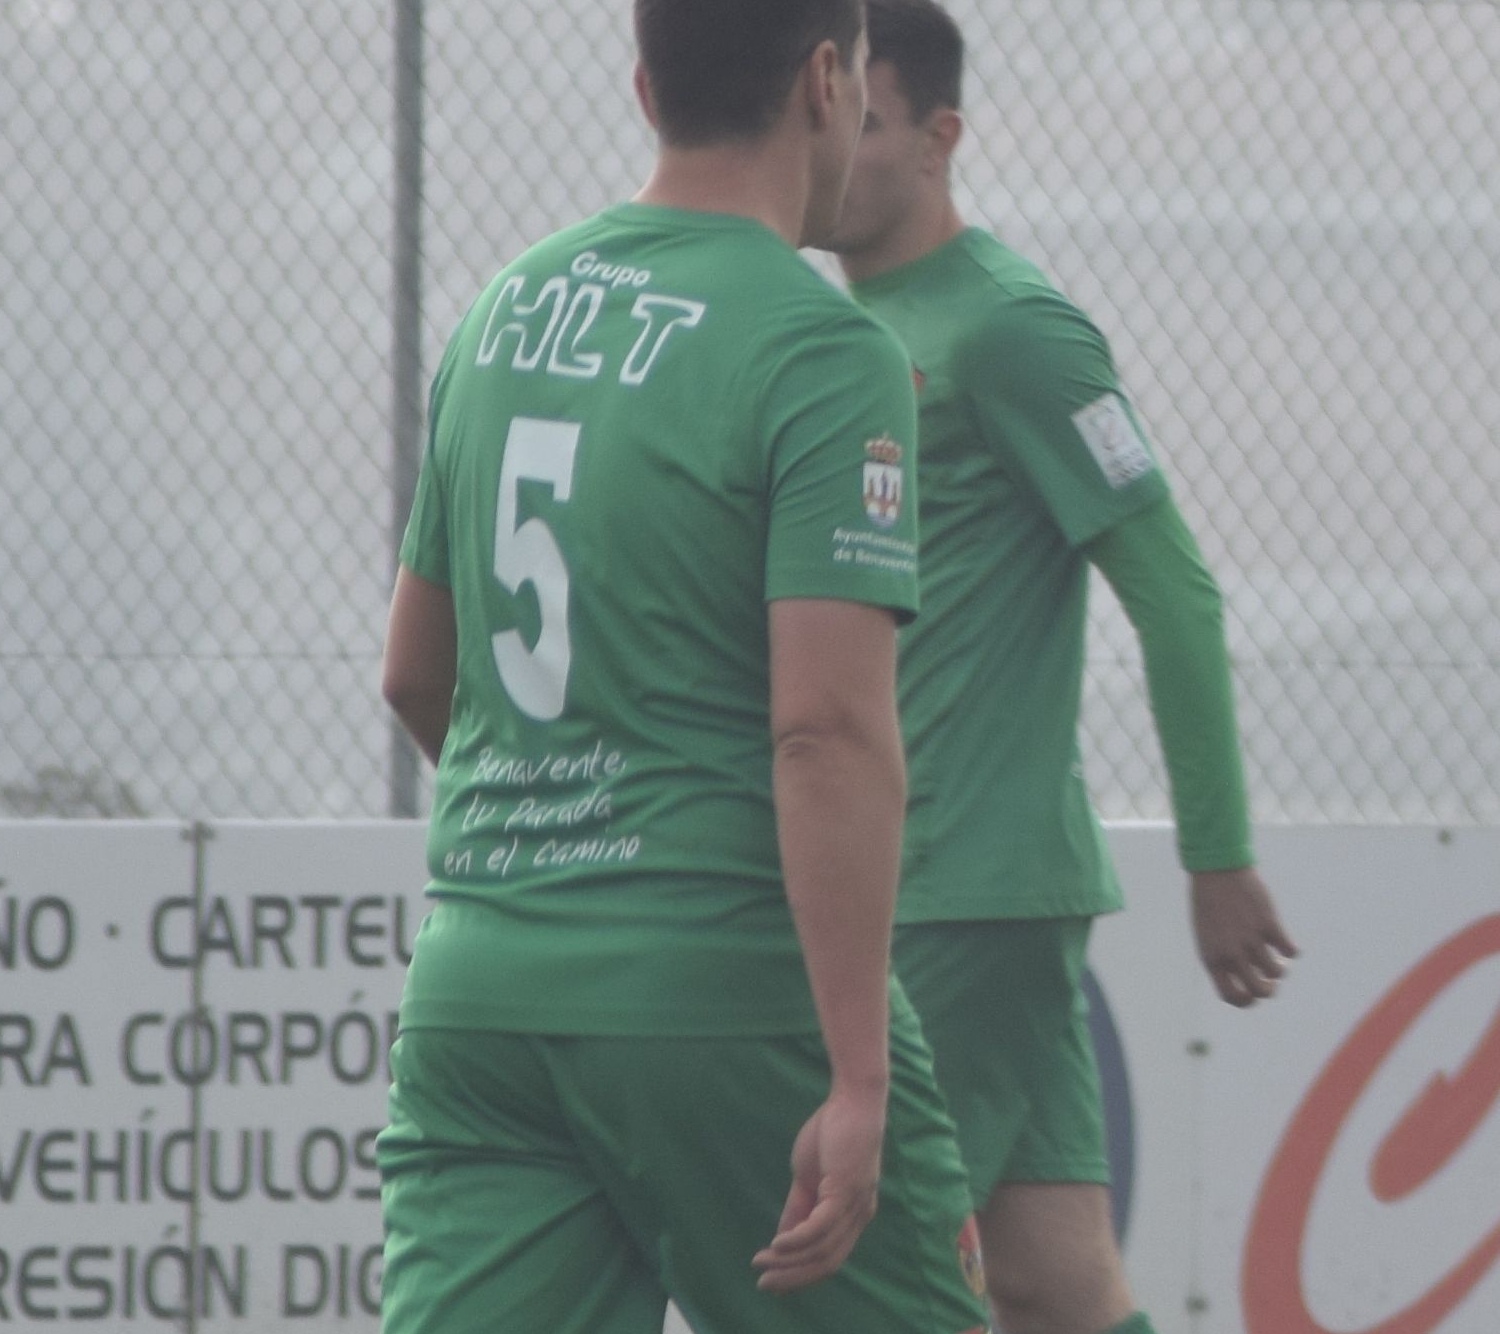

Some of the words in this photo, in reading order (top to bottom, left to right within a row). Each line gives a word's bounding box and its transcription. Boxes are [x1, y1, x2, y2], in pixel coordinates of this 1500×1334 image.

[571, 251, 651, 290] Grupo
[492, 417, 583, 722] 5
[444, 844, 472, 875] en
[487, 834, 518, 878] el
